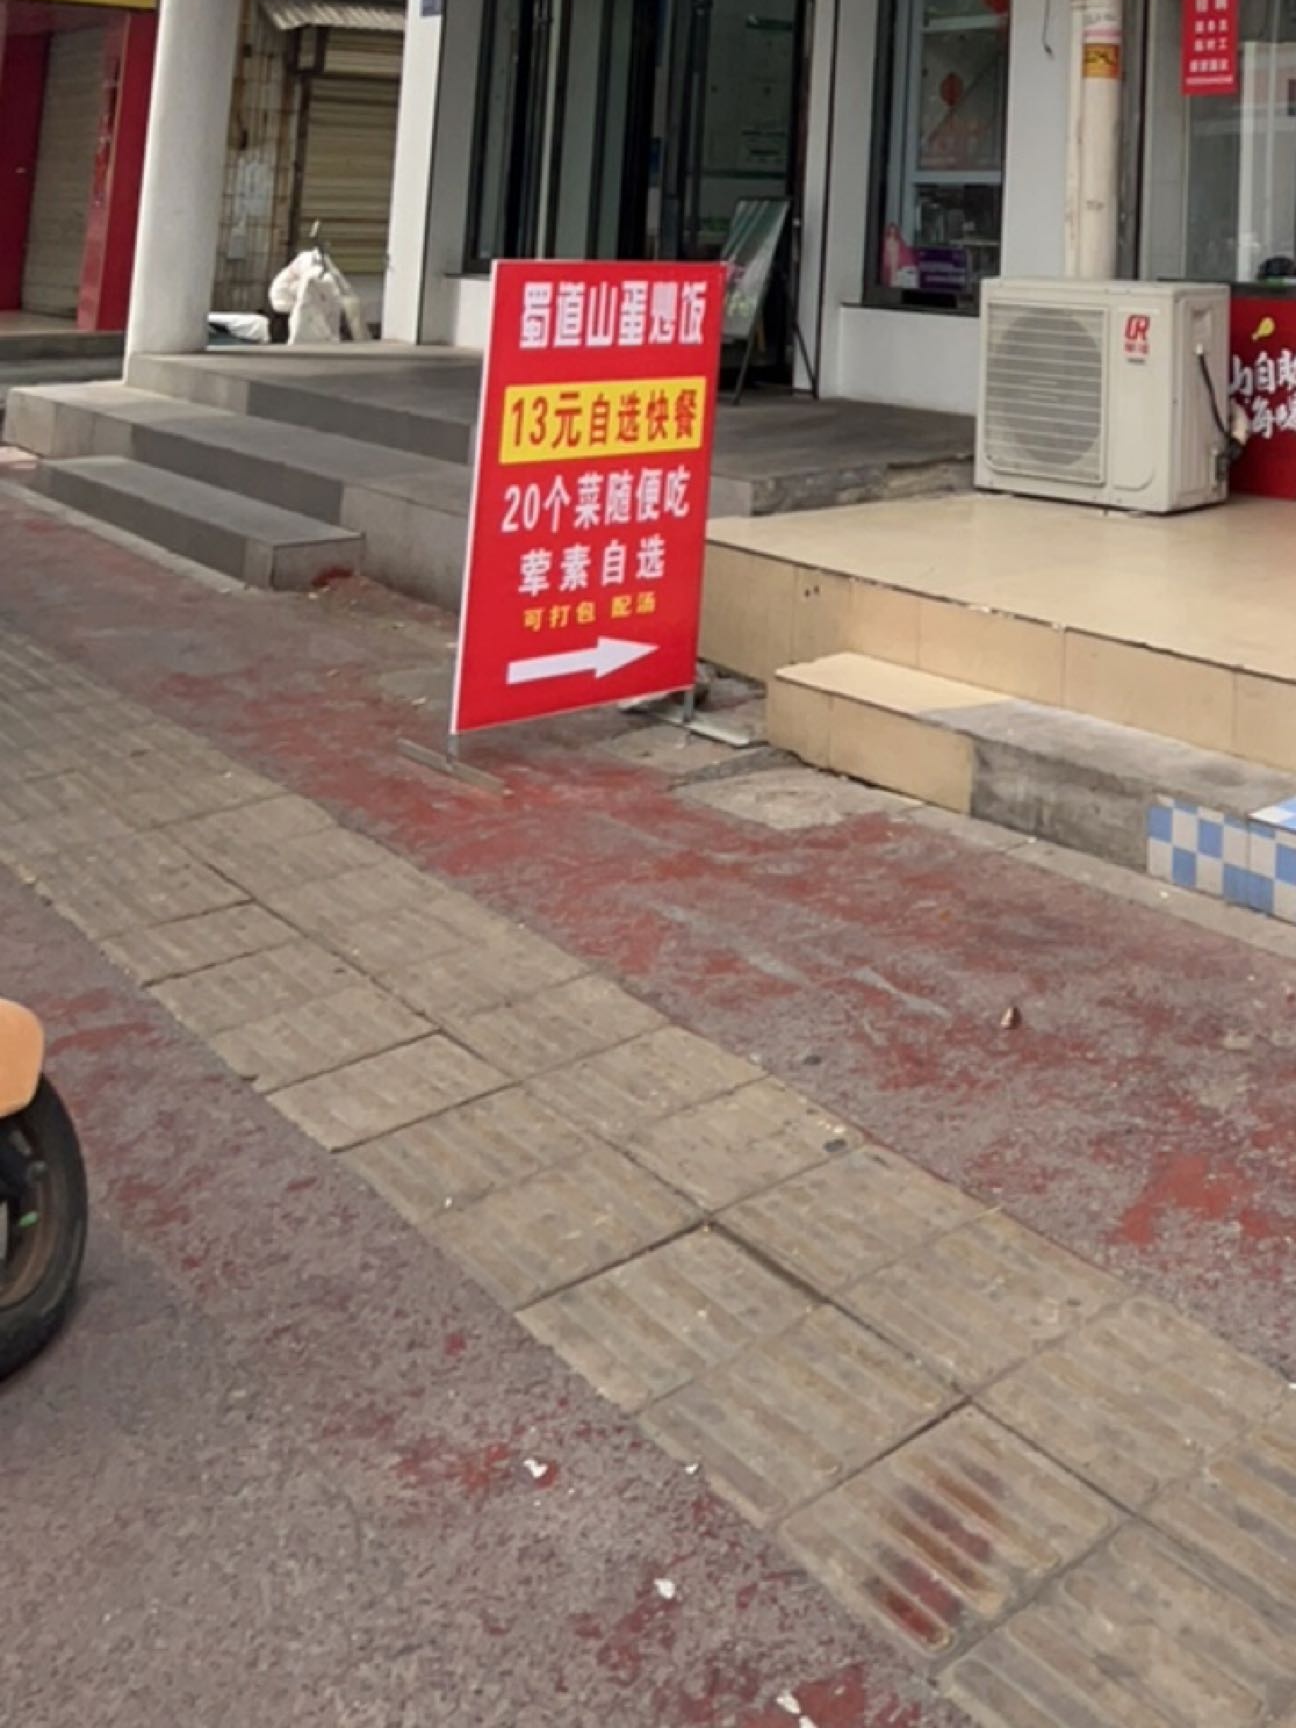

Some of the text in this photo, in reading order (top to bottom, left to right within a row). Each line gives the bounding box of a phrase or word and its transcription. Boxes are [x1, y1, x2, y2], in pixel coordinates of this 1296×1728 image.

[511, 389, 699, 449] 13元自选快餐
[500, 464, 692, 534] 20个菜随便吃
[517, 532, 666, 598] 荤素自选
